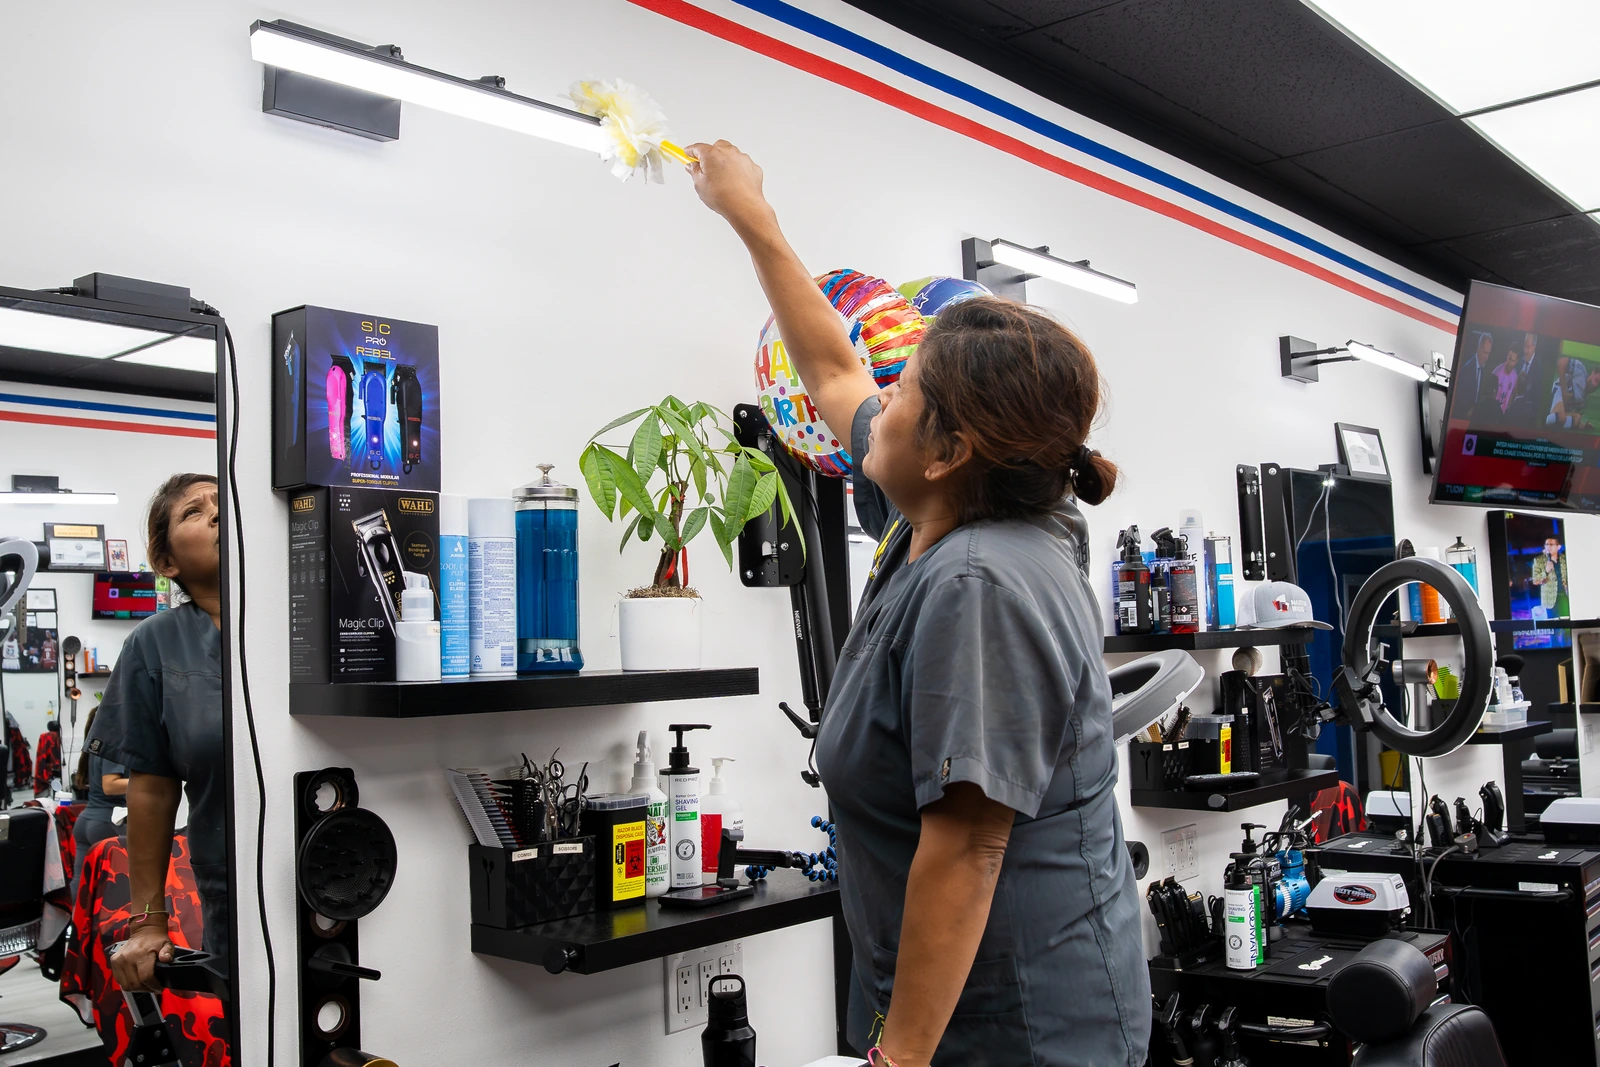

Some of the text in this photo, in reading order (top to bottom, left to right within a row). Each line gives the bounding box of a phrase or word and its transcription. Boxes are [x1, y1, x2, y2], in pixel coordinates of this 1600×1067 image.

[365, 336, 387, 346] PRO
[356, 346, 396, 360] REBEL
[293, 498, 314, 510] WAHL
[400, 501, 432, 511] WAHL
[292, 520, 319, 534] Magic Clip
[339, 618, 385, 630] Magic Clip
